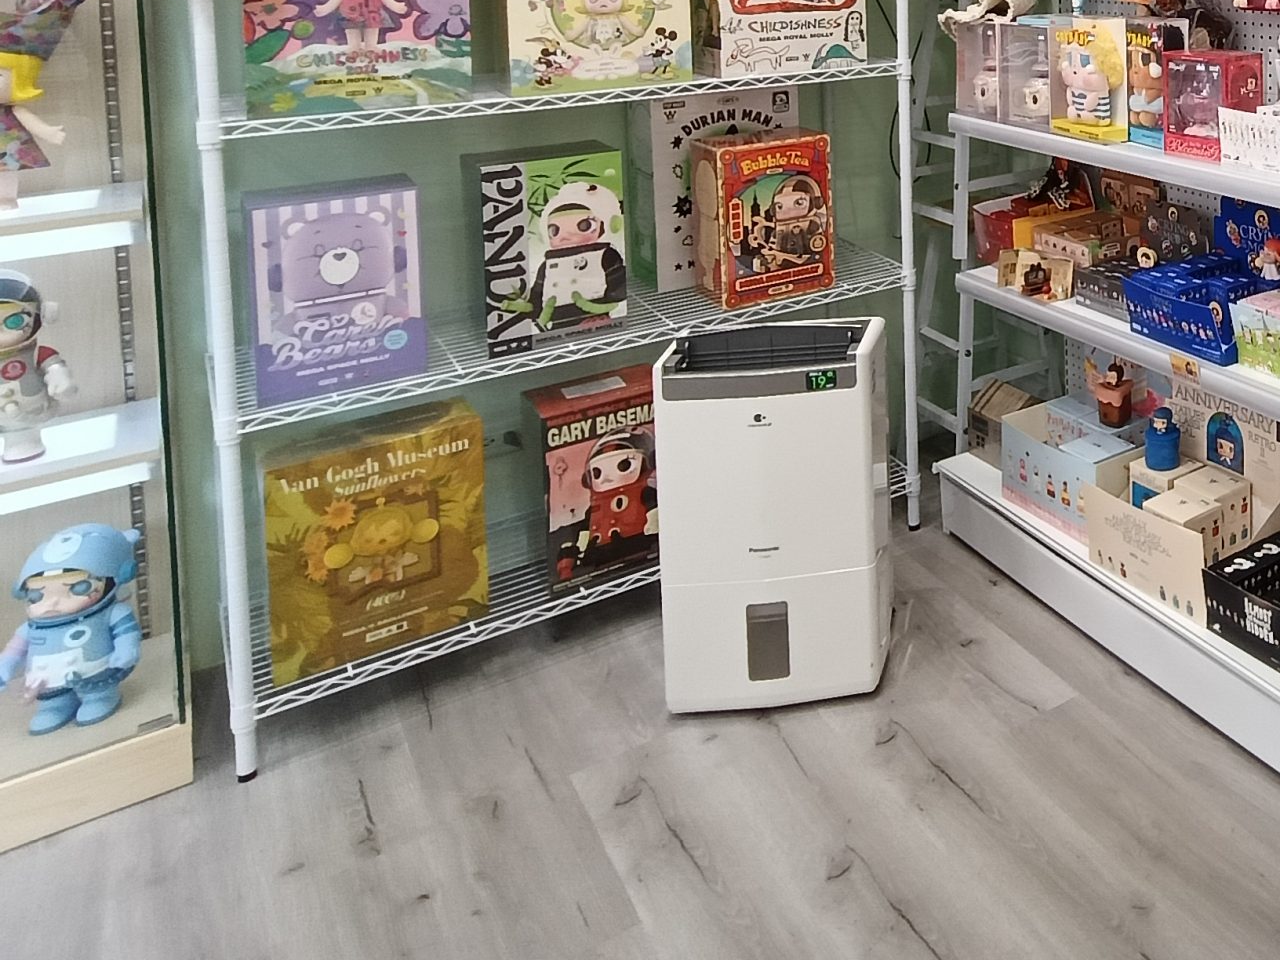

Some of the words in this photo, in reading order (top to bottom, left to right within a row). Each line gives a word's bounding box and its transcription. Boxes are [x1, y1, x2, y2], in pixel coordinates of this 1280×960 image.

[784, 33, 808, 42] ROYAL
[346, 76, 378, 84] ROYAL
[681, 108, 736, 137] DURIAN
[741, 108, 773, 128] MAN
[741, 151, 787, 176] Bubble
[787, 151, 811, 167] Tea
[481, 164, 527, 340] PANDA
[268, 336, 382, 372] Bears
[1175, 384, 1274, 435] ANNIVERSARY
[548, 419, 593, 447] GARY
[596, 403, 655, 436] BASEMA
[1248, 430, 1277, 453] RETRO
[279, 476, 319, 495] Van
[326, 457, 379, 484] Gogh
[387, 438, 469, 468] Museum
[334, 468, 427, 496] Sunflowers
